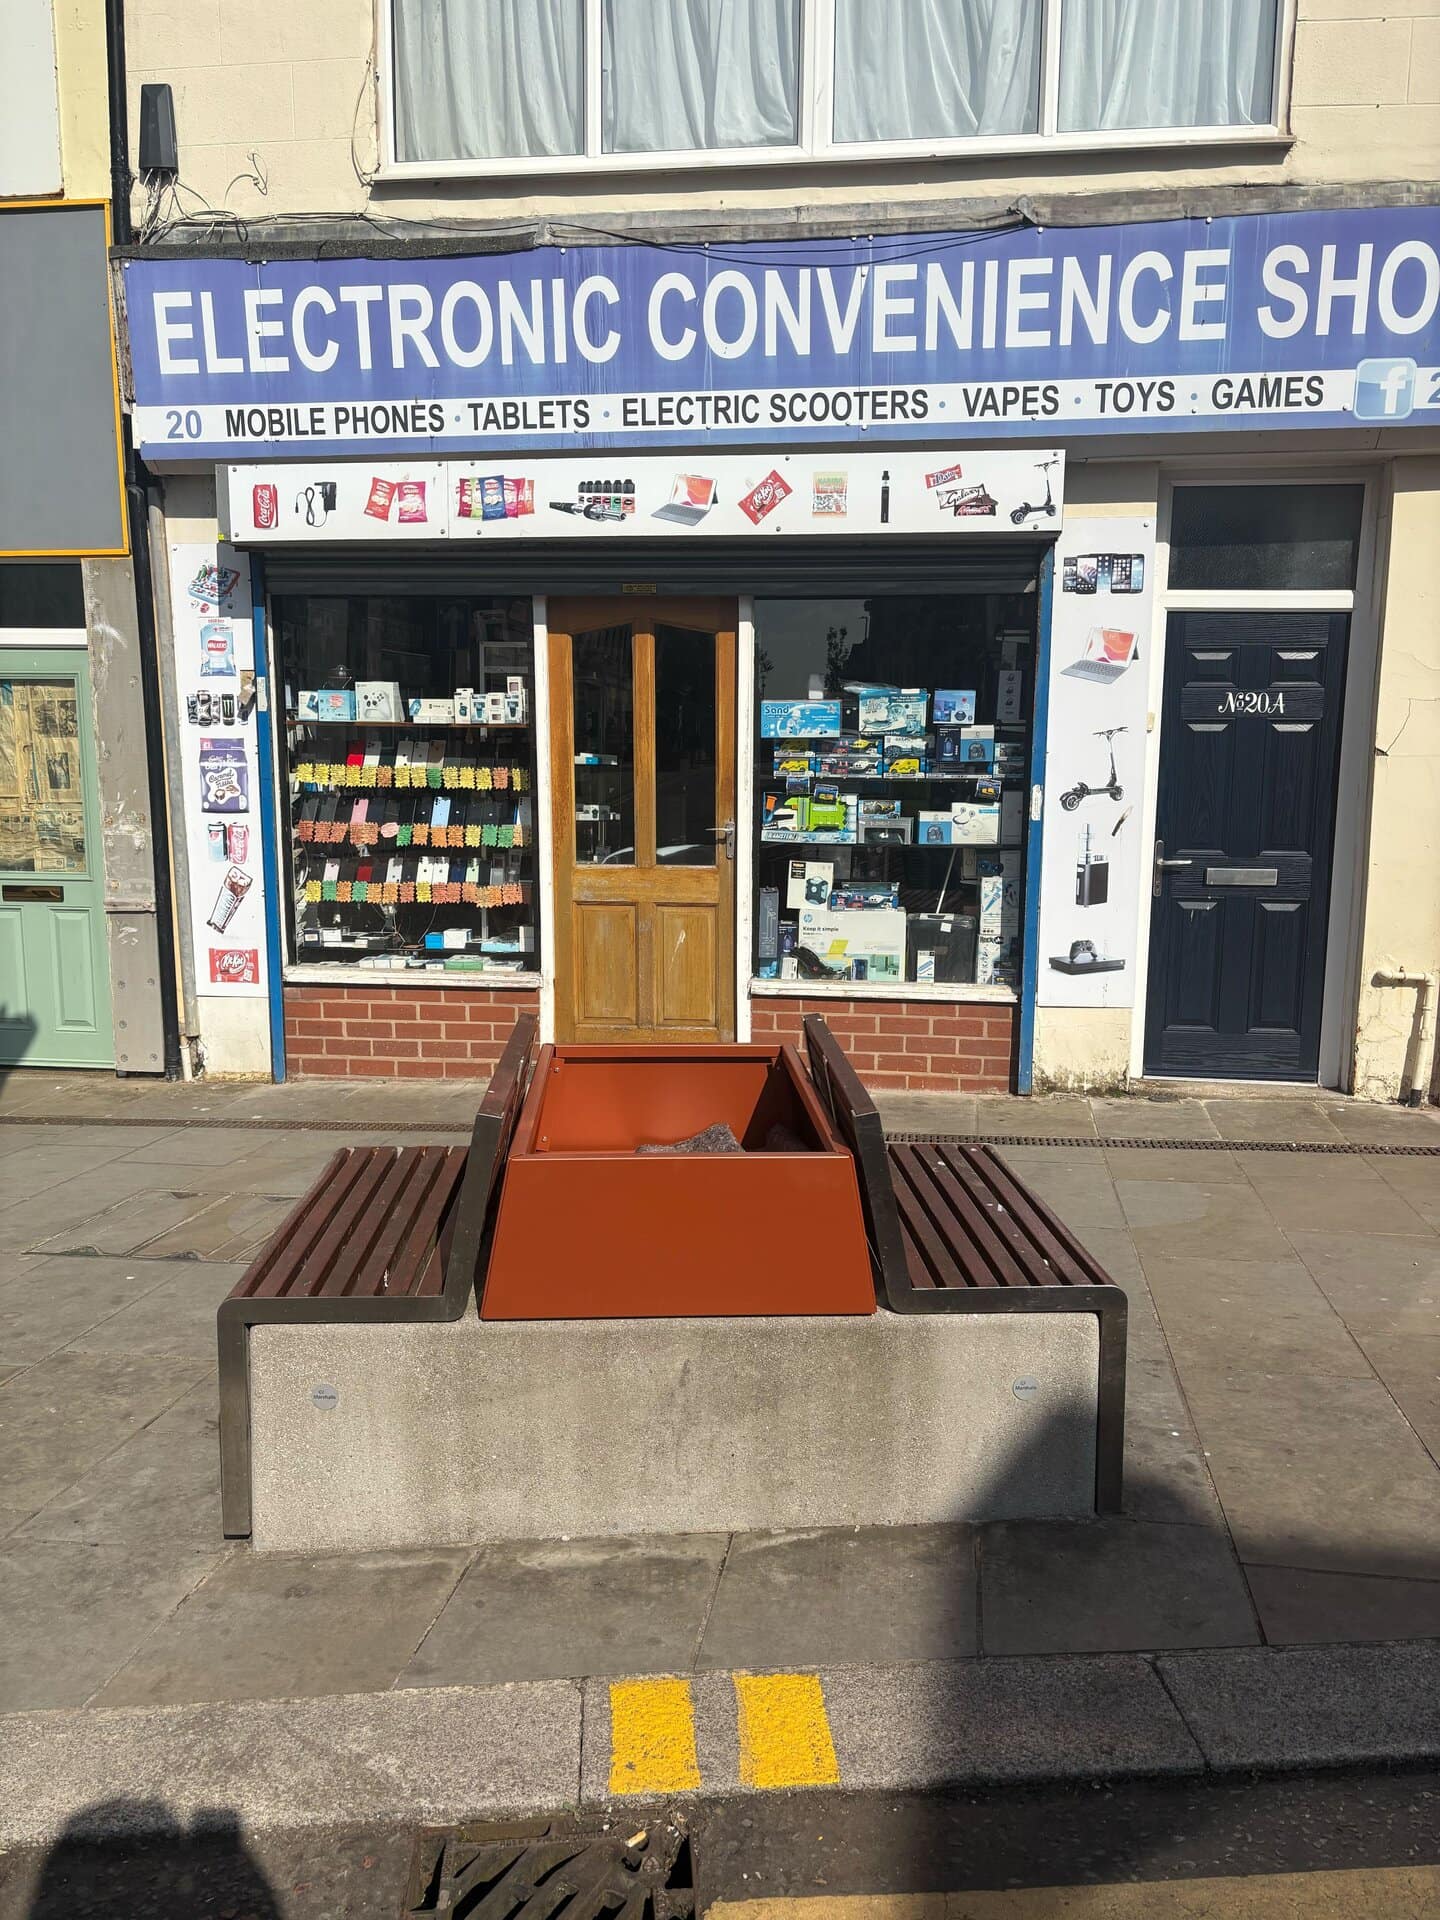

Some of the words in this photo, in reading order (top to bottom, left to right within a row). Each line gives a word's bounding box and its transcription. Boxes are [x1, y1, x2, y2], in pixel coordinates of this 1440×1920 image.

[152, 275, 621, 375] ELECTRONIC
[647, 248, 1231, 361] CONVENIENCE
[1257, 240, 1440, 339] SHO
[167, 410, 202, 439] 20
[225, 408, 326, 437] MOBILE
[334, 404, 445, 434] PHONES
[467, 400, 590, 431] TABLETS
[622, 394, 760, 427] ELECTRIC
[769, 389, 928, 423] SCOOTERS
[962, 386, 1059, 417] VAPES
[1094, 381, 1175, 413] TOYS
[1211, 376, 1324, 410] GAMES
[946, 488, 980, 507] Galaxy
[765, 705, 789, 714] Sand
